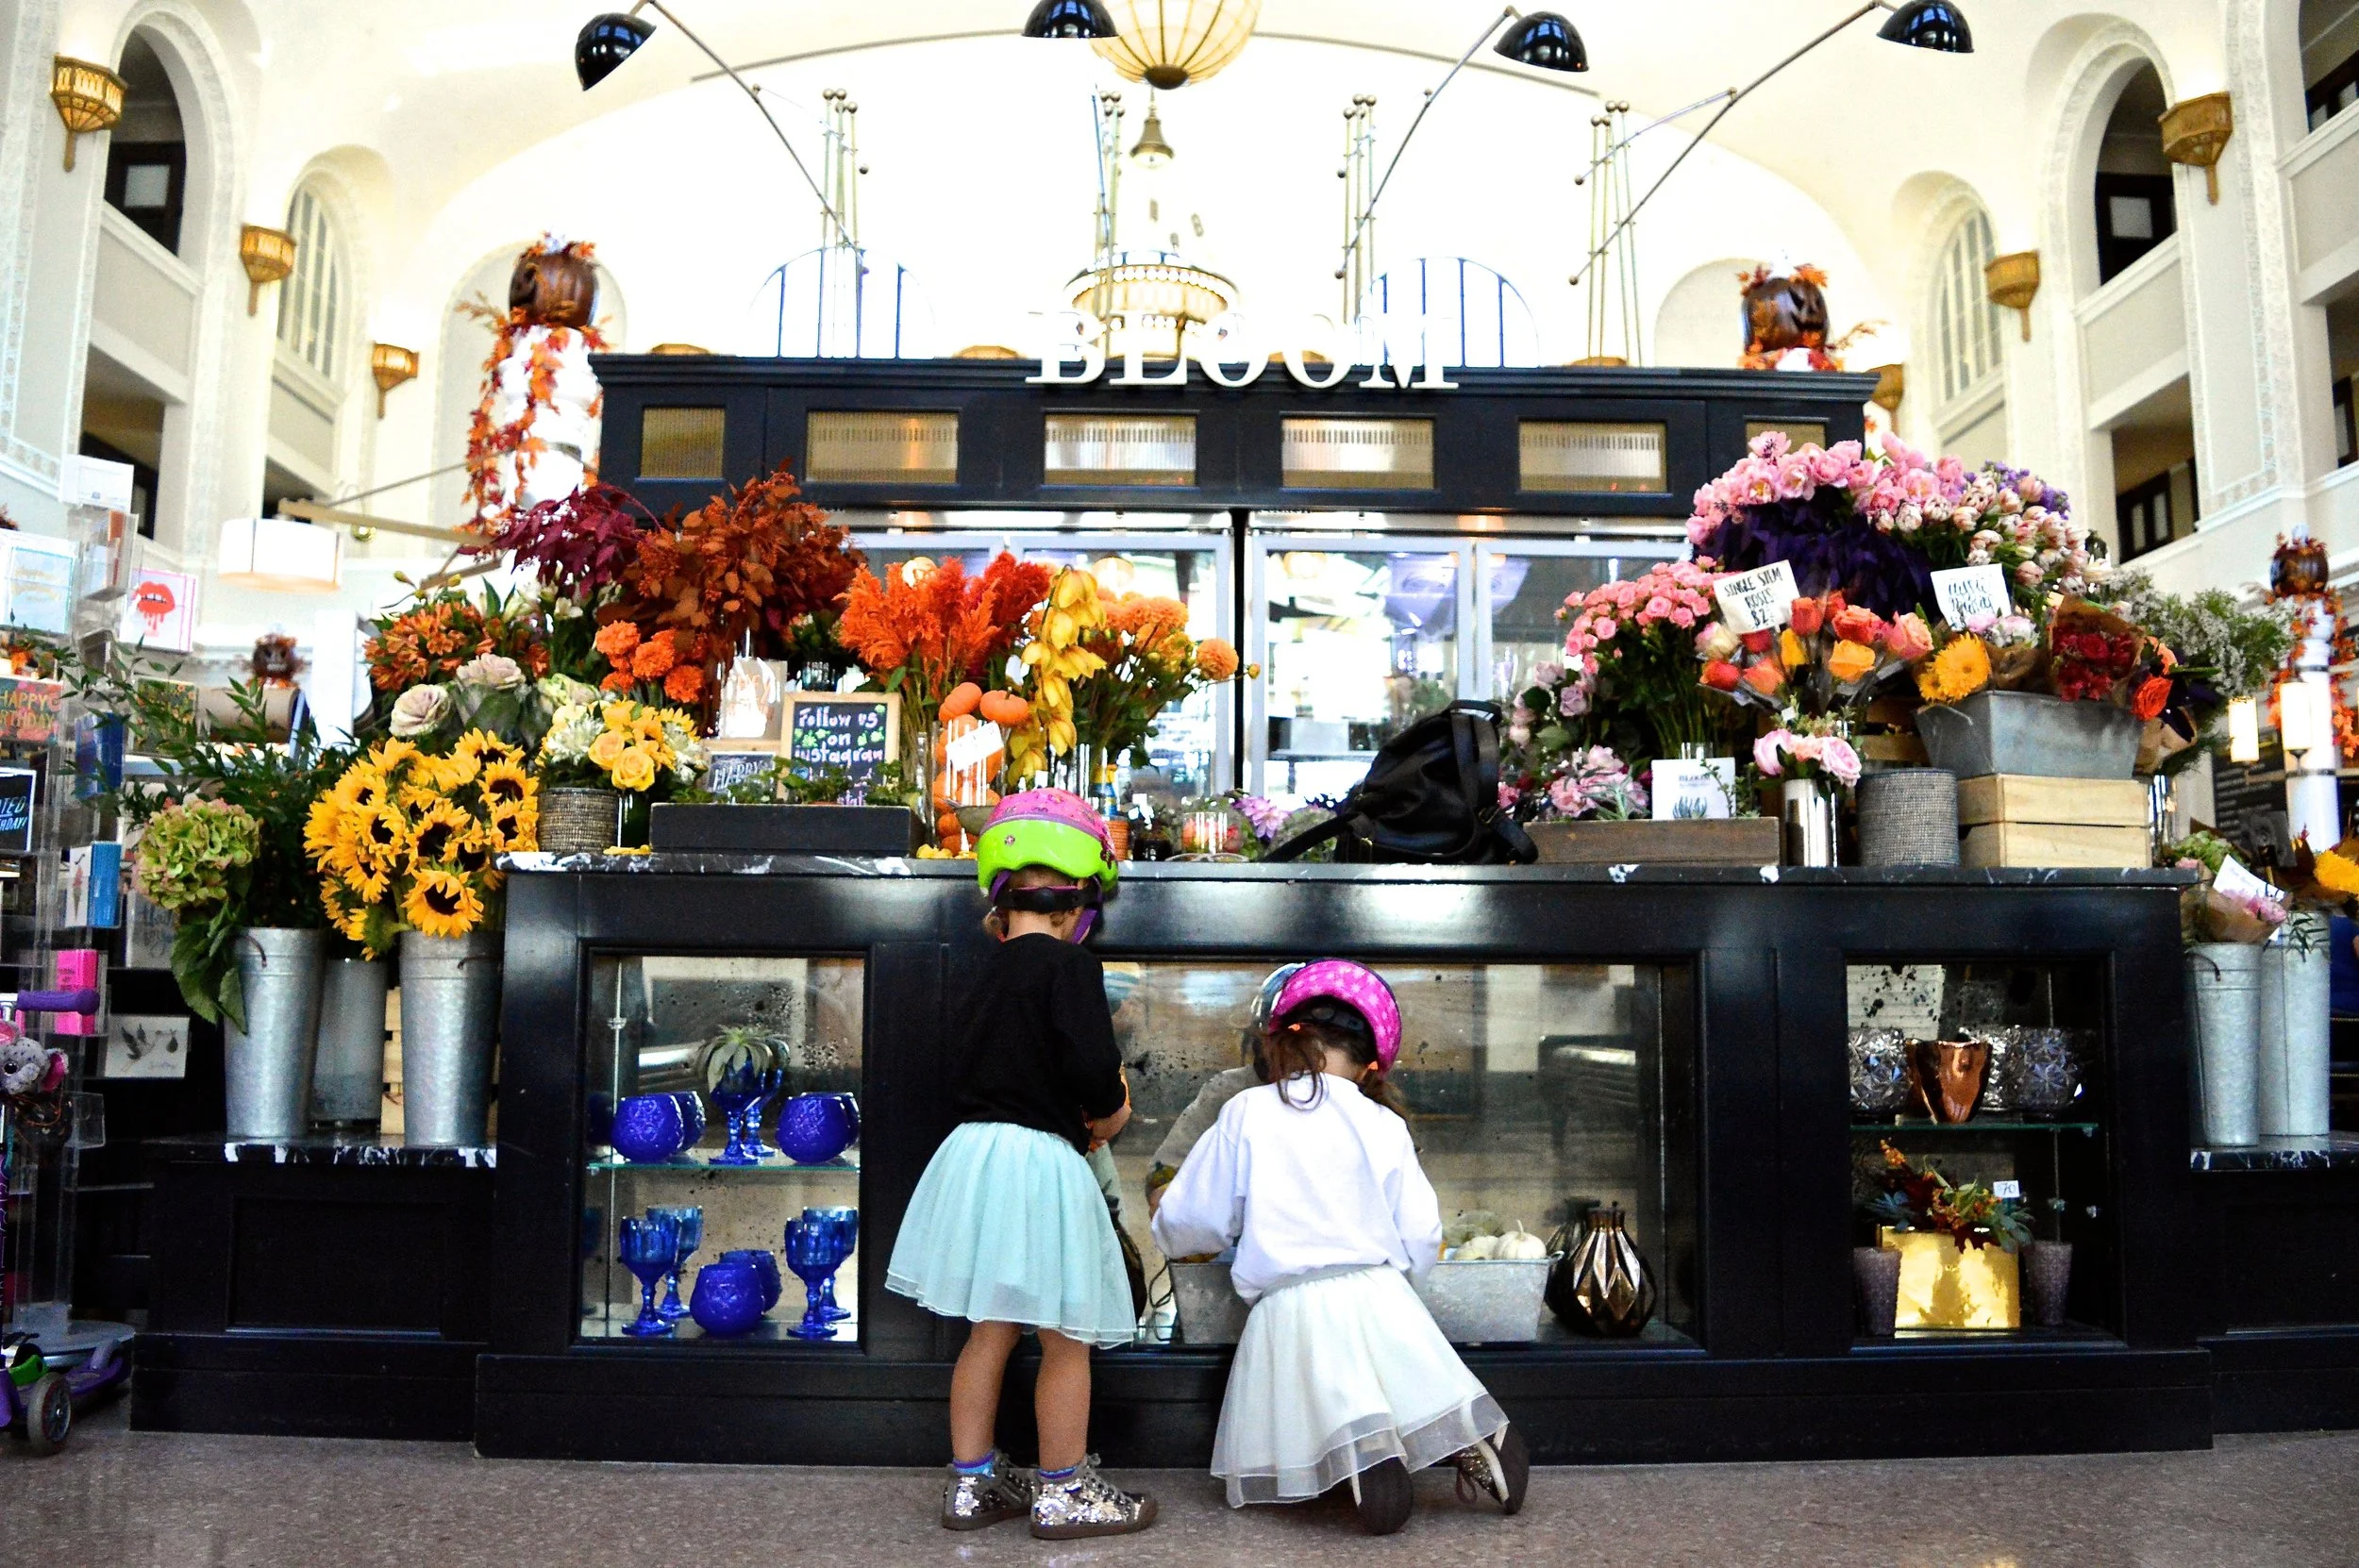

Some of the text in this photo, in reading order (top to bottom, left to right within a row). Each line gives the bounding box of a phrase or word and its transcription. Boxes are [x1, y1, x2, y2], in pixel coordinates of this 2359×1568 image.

[1027, 310, 1459, 389] BLOOM
[1724, 576, 1756, 597] SINGLE
[1744, 587, 1775, 609] ROSES
[799, 706, 878, 728] Follow us
[828, 732, 852, 746] on
